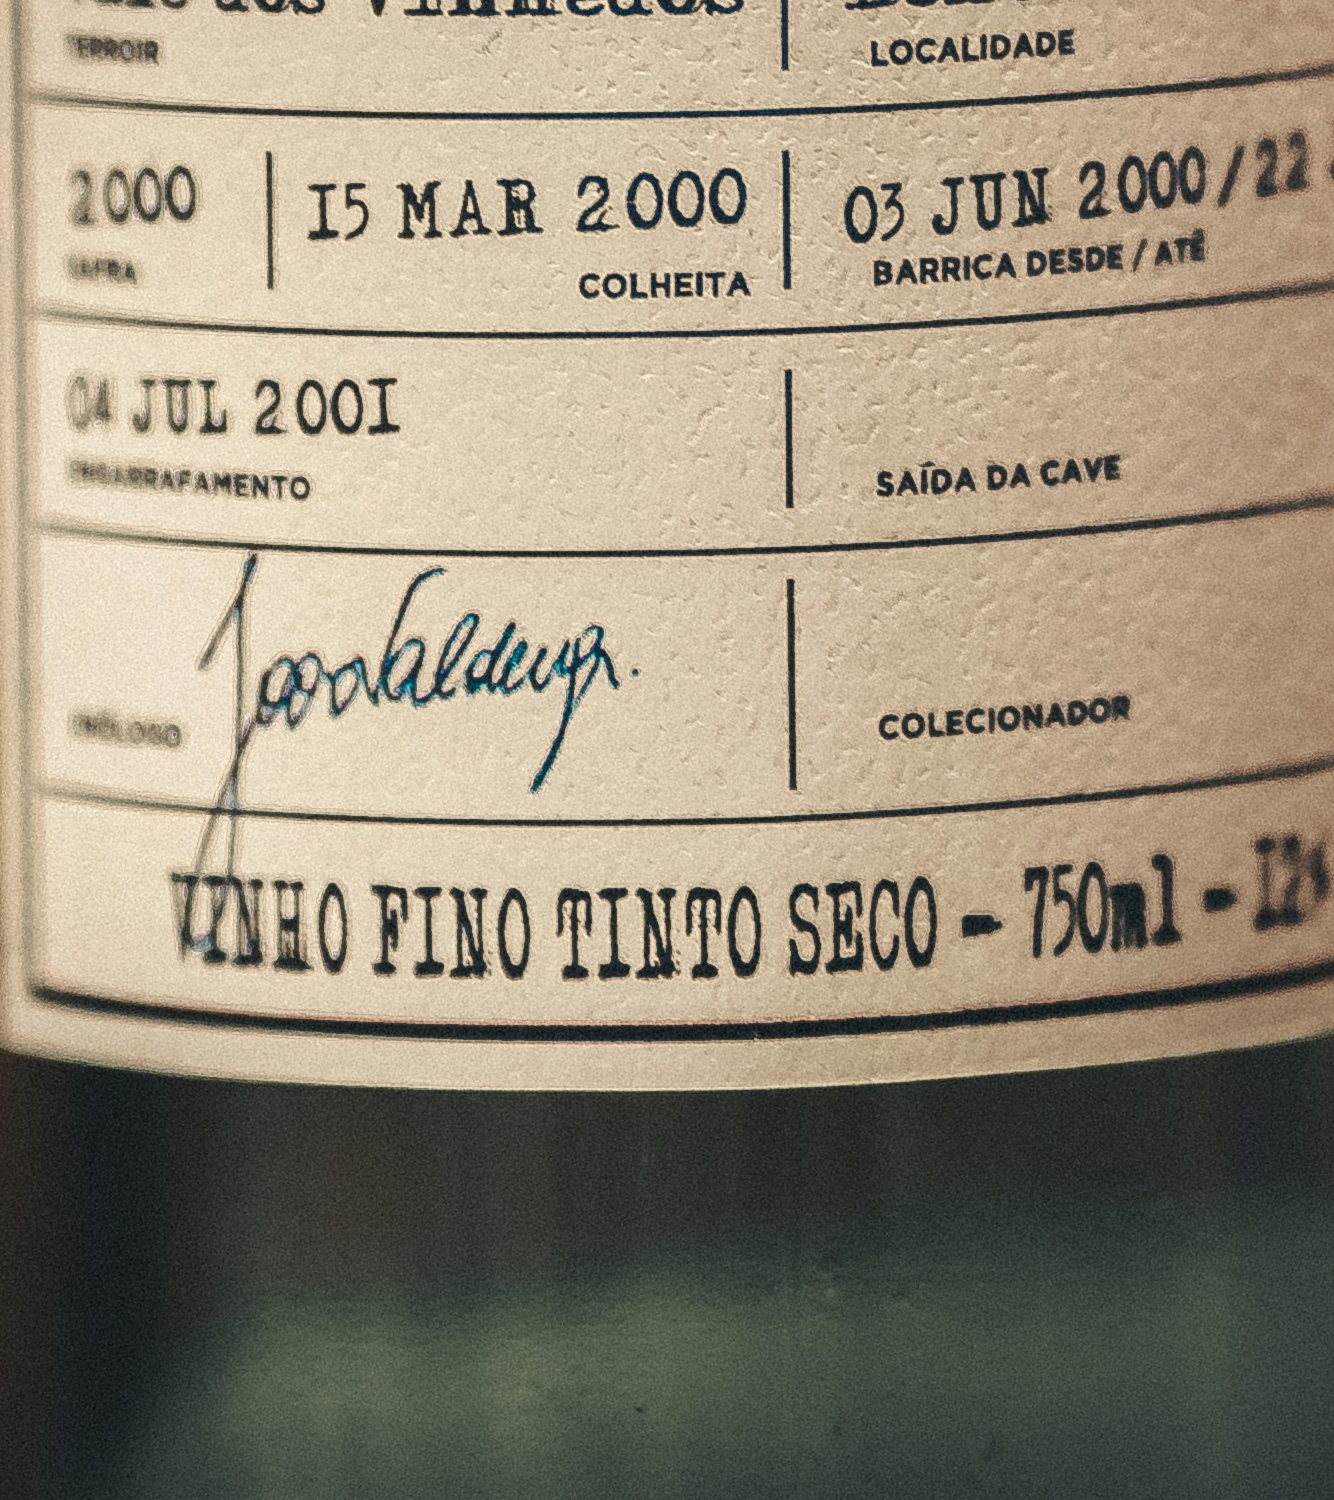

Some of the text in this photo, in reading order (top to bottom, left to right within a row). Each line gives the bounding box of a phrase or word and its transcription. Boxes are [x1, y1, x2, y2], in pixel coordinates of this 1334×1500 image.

[869, 26, 1077, 69] LOCALIDADE
[71, 163, 199, 227] 2000
[395, 176, 545, 241] MAR
[575, 166, 749, 234] 2000
[842, 180, 906, 245] 03
[930, 165, 1053, 237] JUN
[577, 269, 752, 301] COLHEITA
[872, 251, 1018, 288] BARRICA
[1025, 242, 1125, 279] DESDE
[130, 376, 230, 437] JUL
[875, 452, 1123, 499] SAÍDA DA CAVE
[877, 692, 1133, 742] COLECIONADOR
[169, 870, 350, 976] VINHO
[369, 882, 533, 982] FINO
[555, 883, 764, 982] TINTO
[786, 874, 940, 978] SECO
[1022, 851, 1185, 960] 750ml
